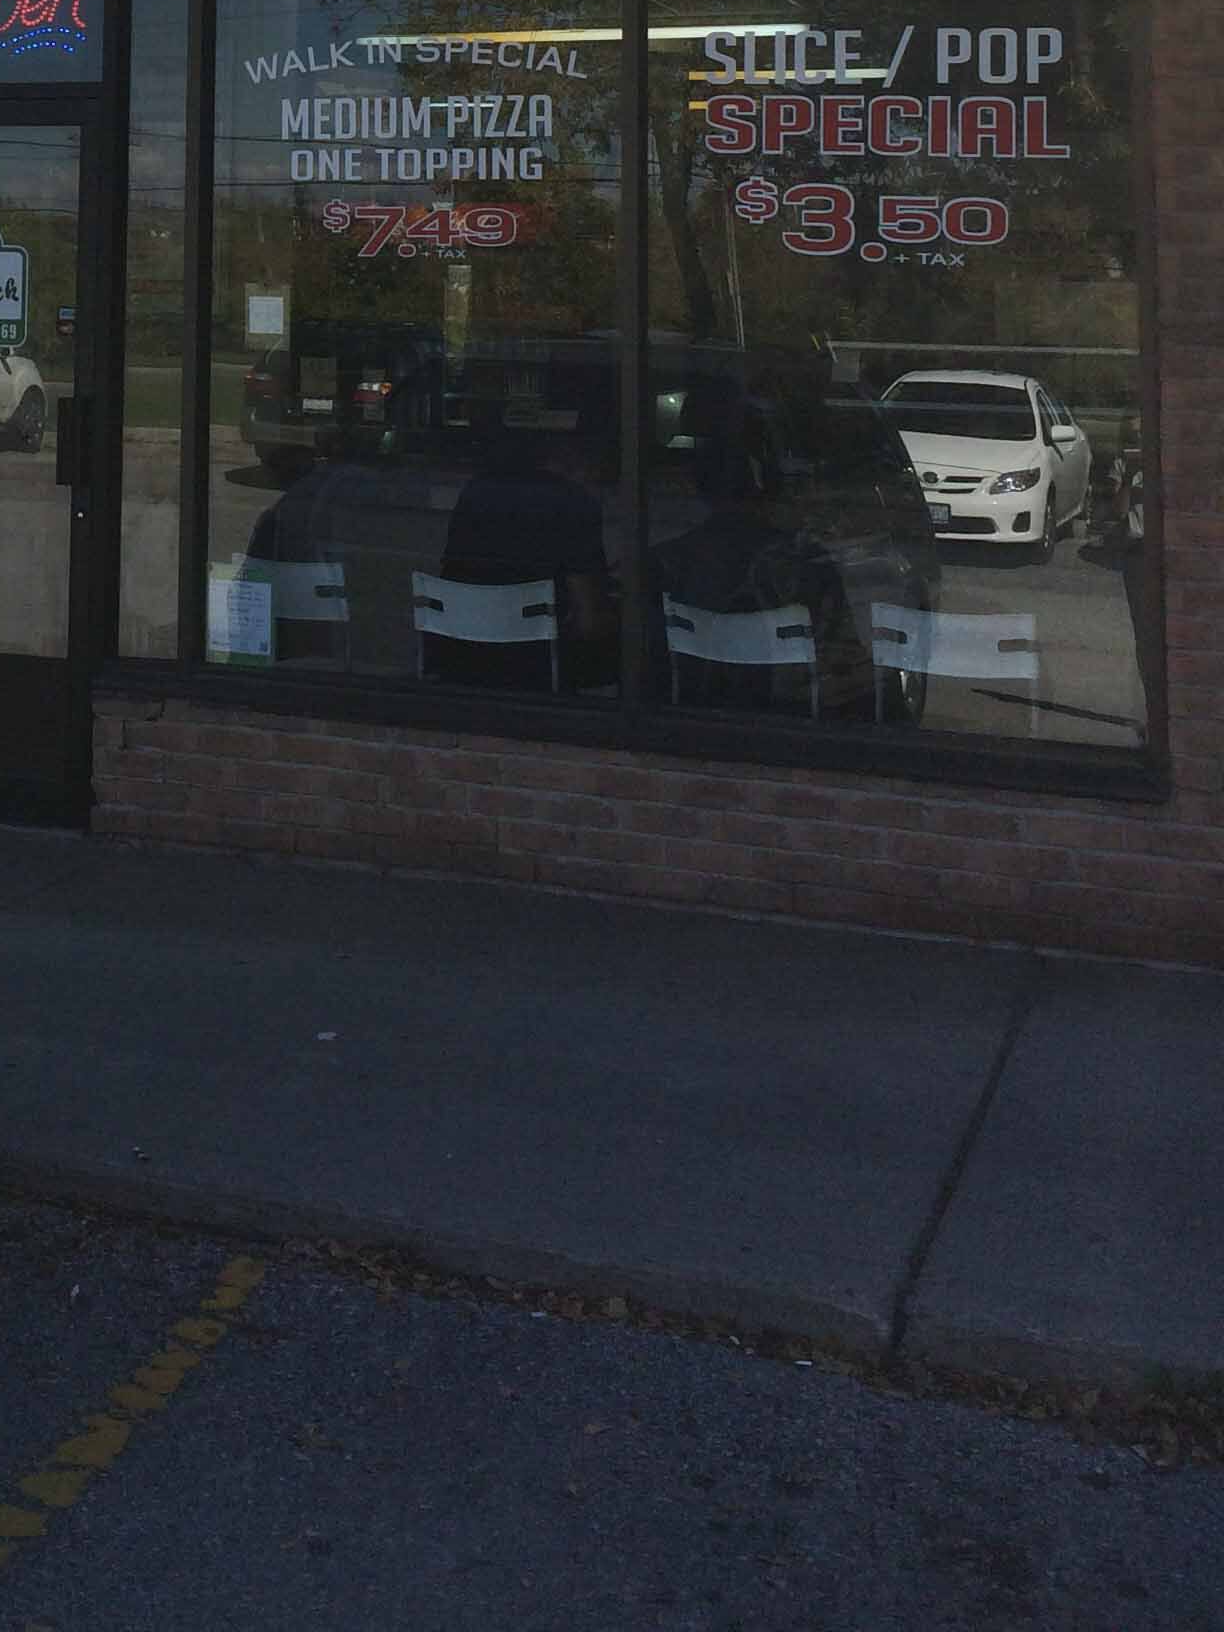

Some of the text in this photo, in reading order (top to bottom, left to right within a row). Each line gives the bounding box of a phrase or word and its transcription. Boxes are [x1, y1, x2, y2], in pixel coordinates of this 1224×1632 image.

[244, 36, 588, 85] WALK IN SPECIAL
[704, 29, 863, 86] SLICE
[936, 27, 1064, 85] POP
[281, 94, 553, 140] MEDIUM PIZZA
[704, 94, 1072, 159] SPECIAL
[290, 147, 544, 181] ONE TOPPING
[734, 176, 1009, 263] $3.50
[435, 248, 466, 259] TAX
[918, 252, 967, 267] TAX
